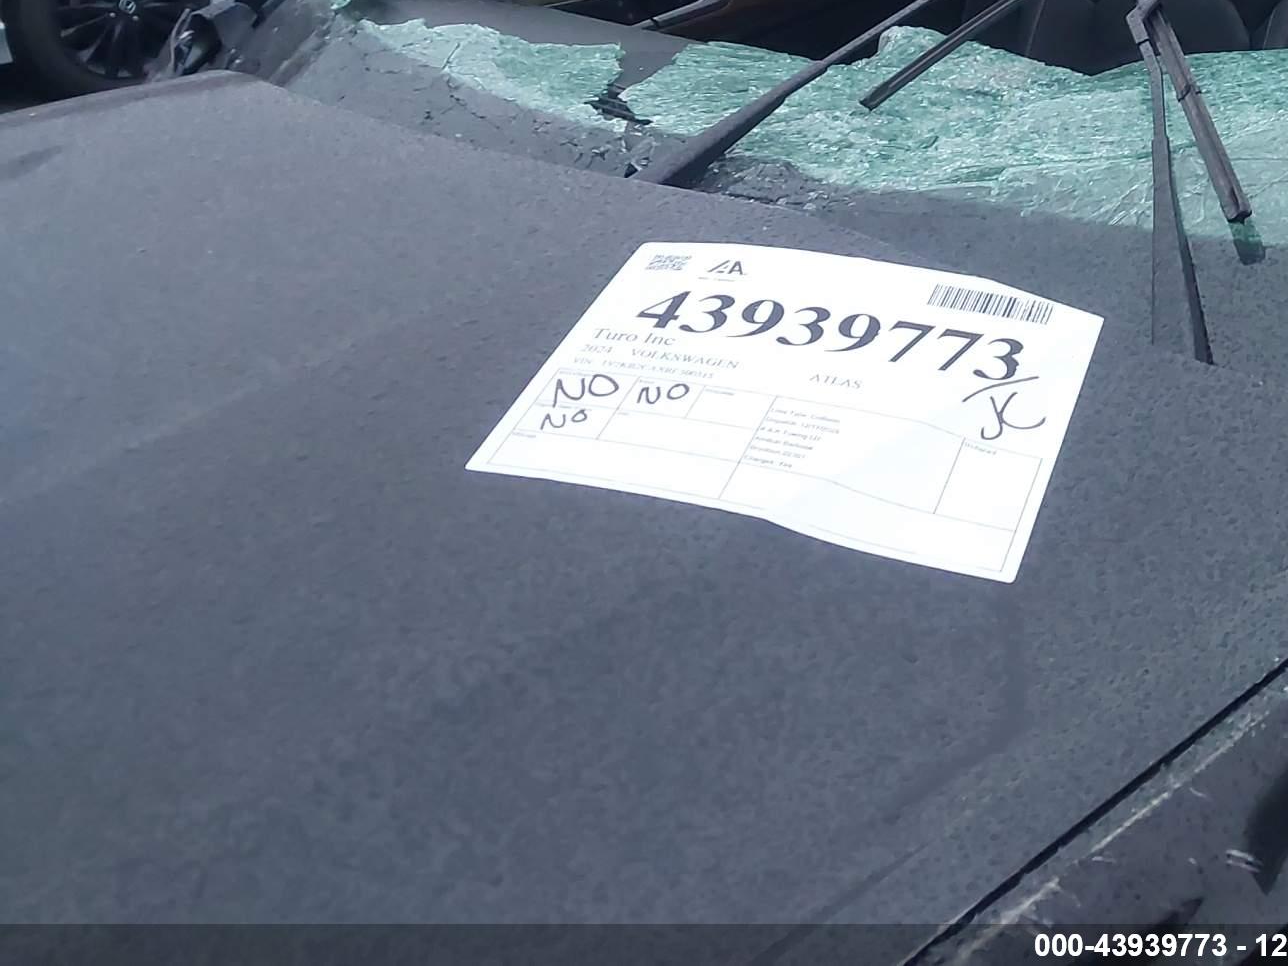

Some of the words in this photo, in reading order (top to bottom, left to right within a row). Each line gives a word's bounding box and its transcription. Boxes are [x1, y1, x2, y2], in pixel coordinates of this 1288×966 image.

[593, 327, 638, 343] Turo
[643, 332, 677, 346] Inc
[635, 290, 1026, 381] 43939773
[630, 347, 741, 370] VOLKSWAGEN
[552, 373, 620, 408] NO
[809, 373, 862, 389] ATLAS
[636, 382, 690, 405] NO
